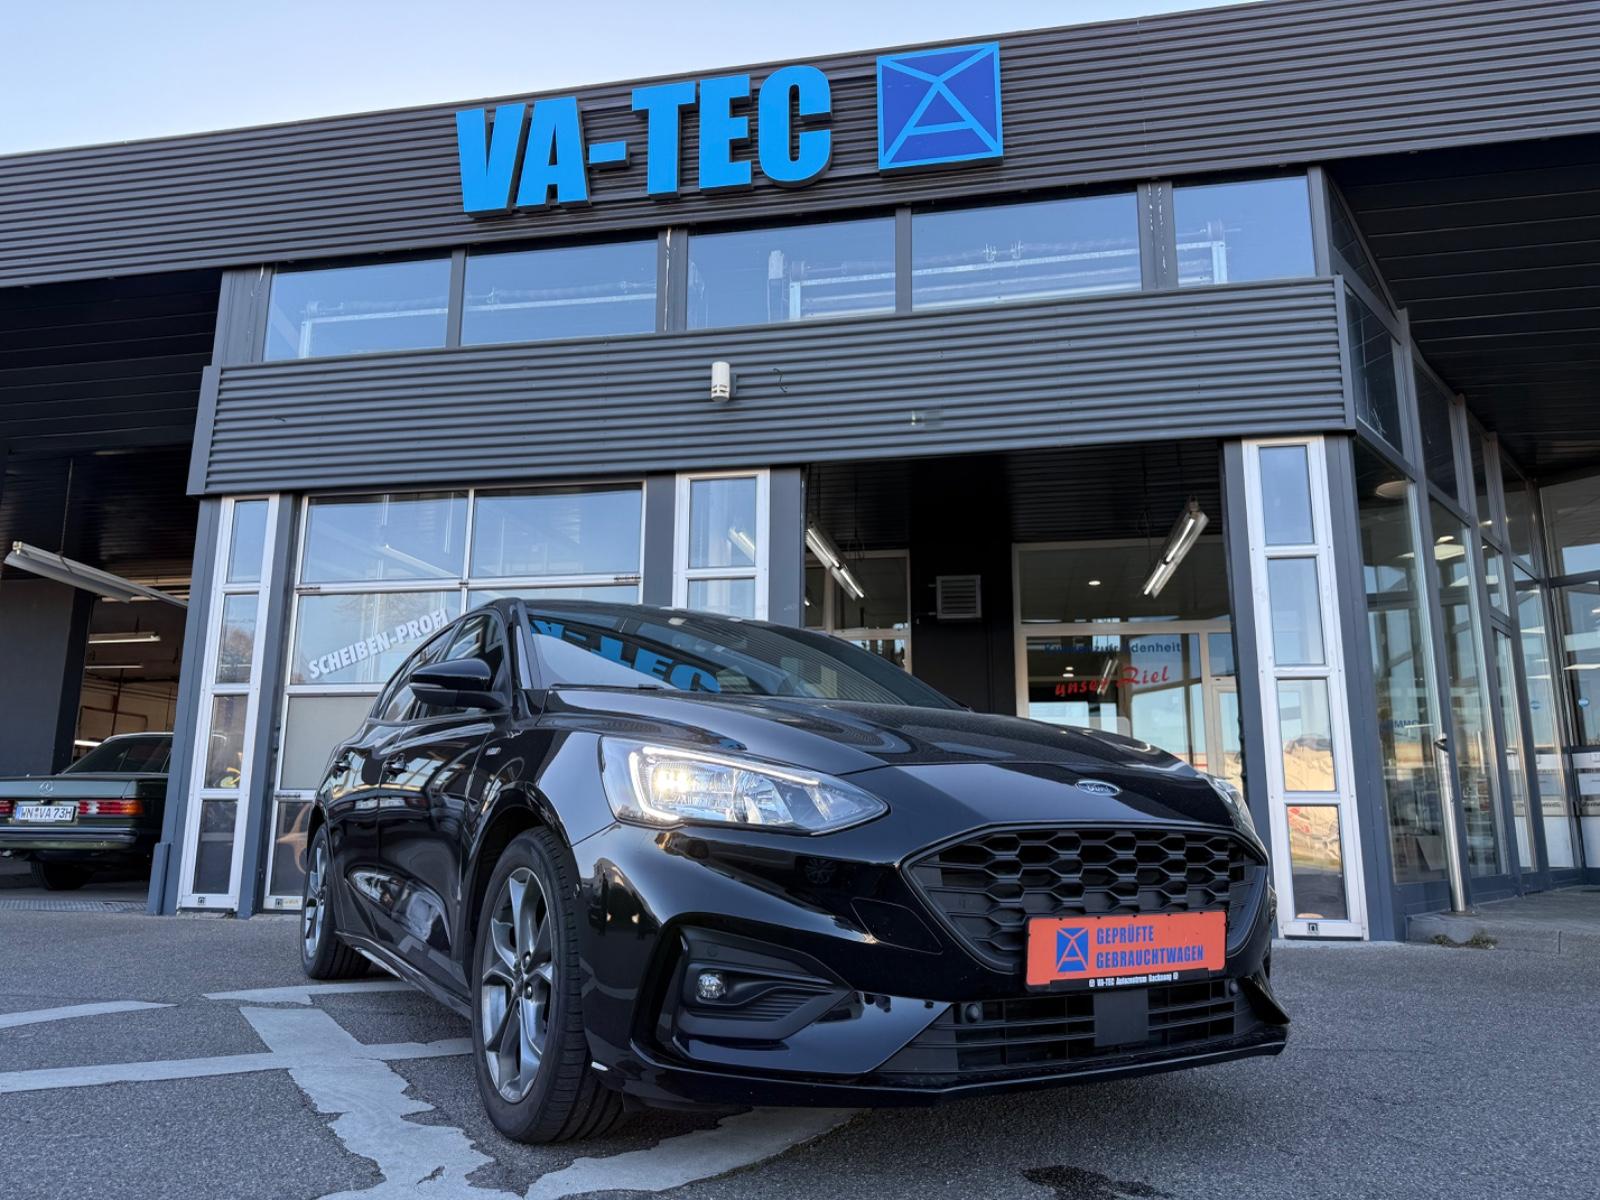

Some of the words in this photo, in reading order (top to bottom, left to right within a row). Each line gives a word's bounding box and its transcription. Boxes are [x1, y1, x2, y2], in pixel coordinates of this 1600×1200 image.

[456, 65, 832, 214] VA-TEC
[308, 608, 449, 679] SCHEIBEN-PROFI
[1116, 666, 1170, 688] Ziel
[53, 808, 72, 818] 73H
[1096, 924, 1154, 945] GEPRÜFTE
[1096, 945, 1204, 969] GEBRAUCHTWAGEN
